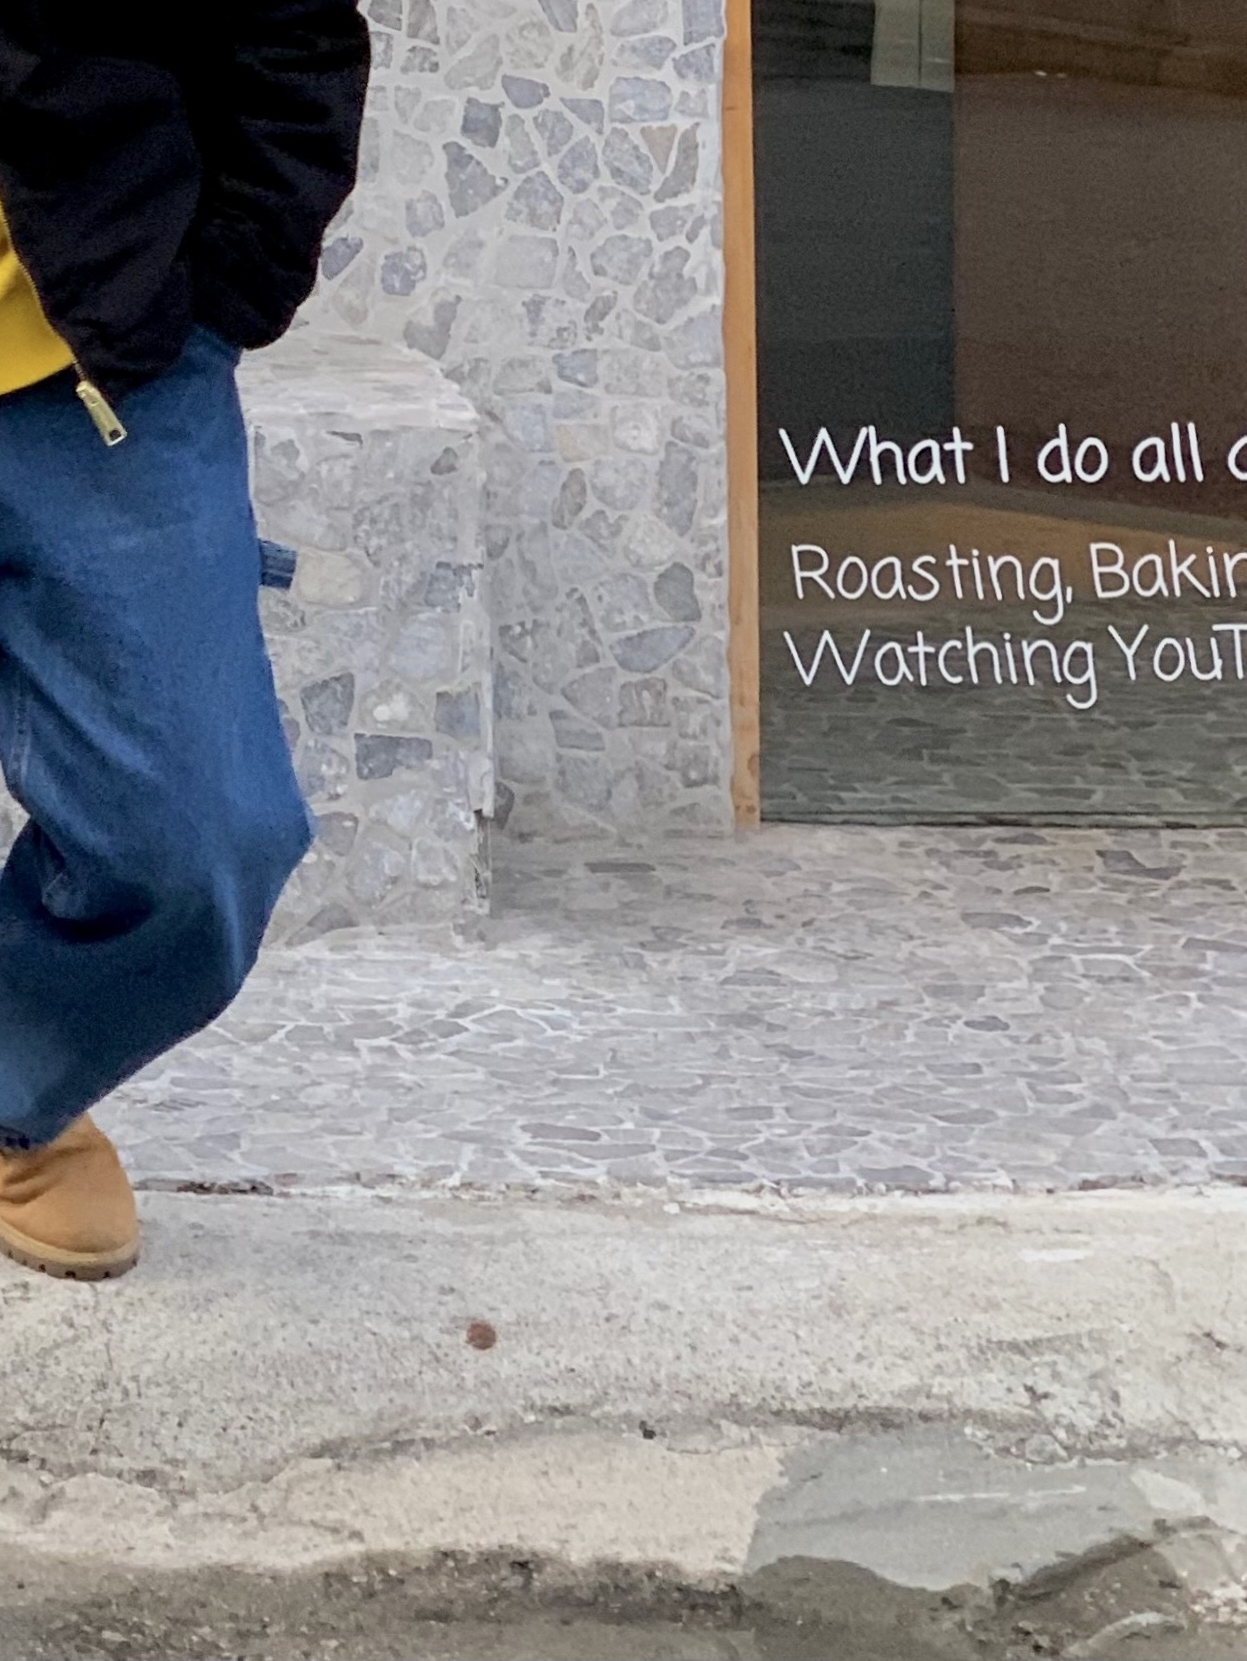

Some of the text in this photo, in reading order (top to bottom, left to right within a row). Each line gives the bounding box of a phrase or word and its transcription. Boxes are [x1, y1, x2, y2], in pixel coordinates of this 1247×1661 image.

[778, 424, 974, 485] What
[996, 425, 1010, 483] I
[1037, 423, 1109, 483] do
[1132, 421, 1205, 483] all
[791, 544, 1073, 625] Roasting,
[783, 625, 1098, 709] Watching
